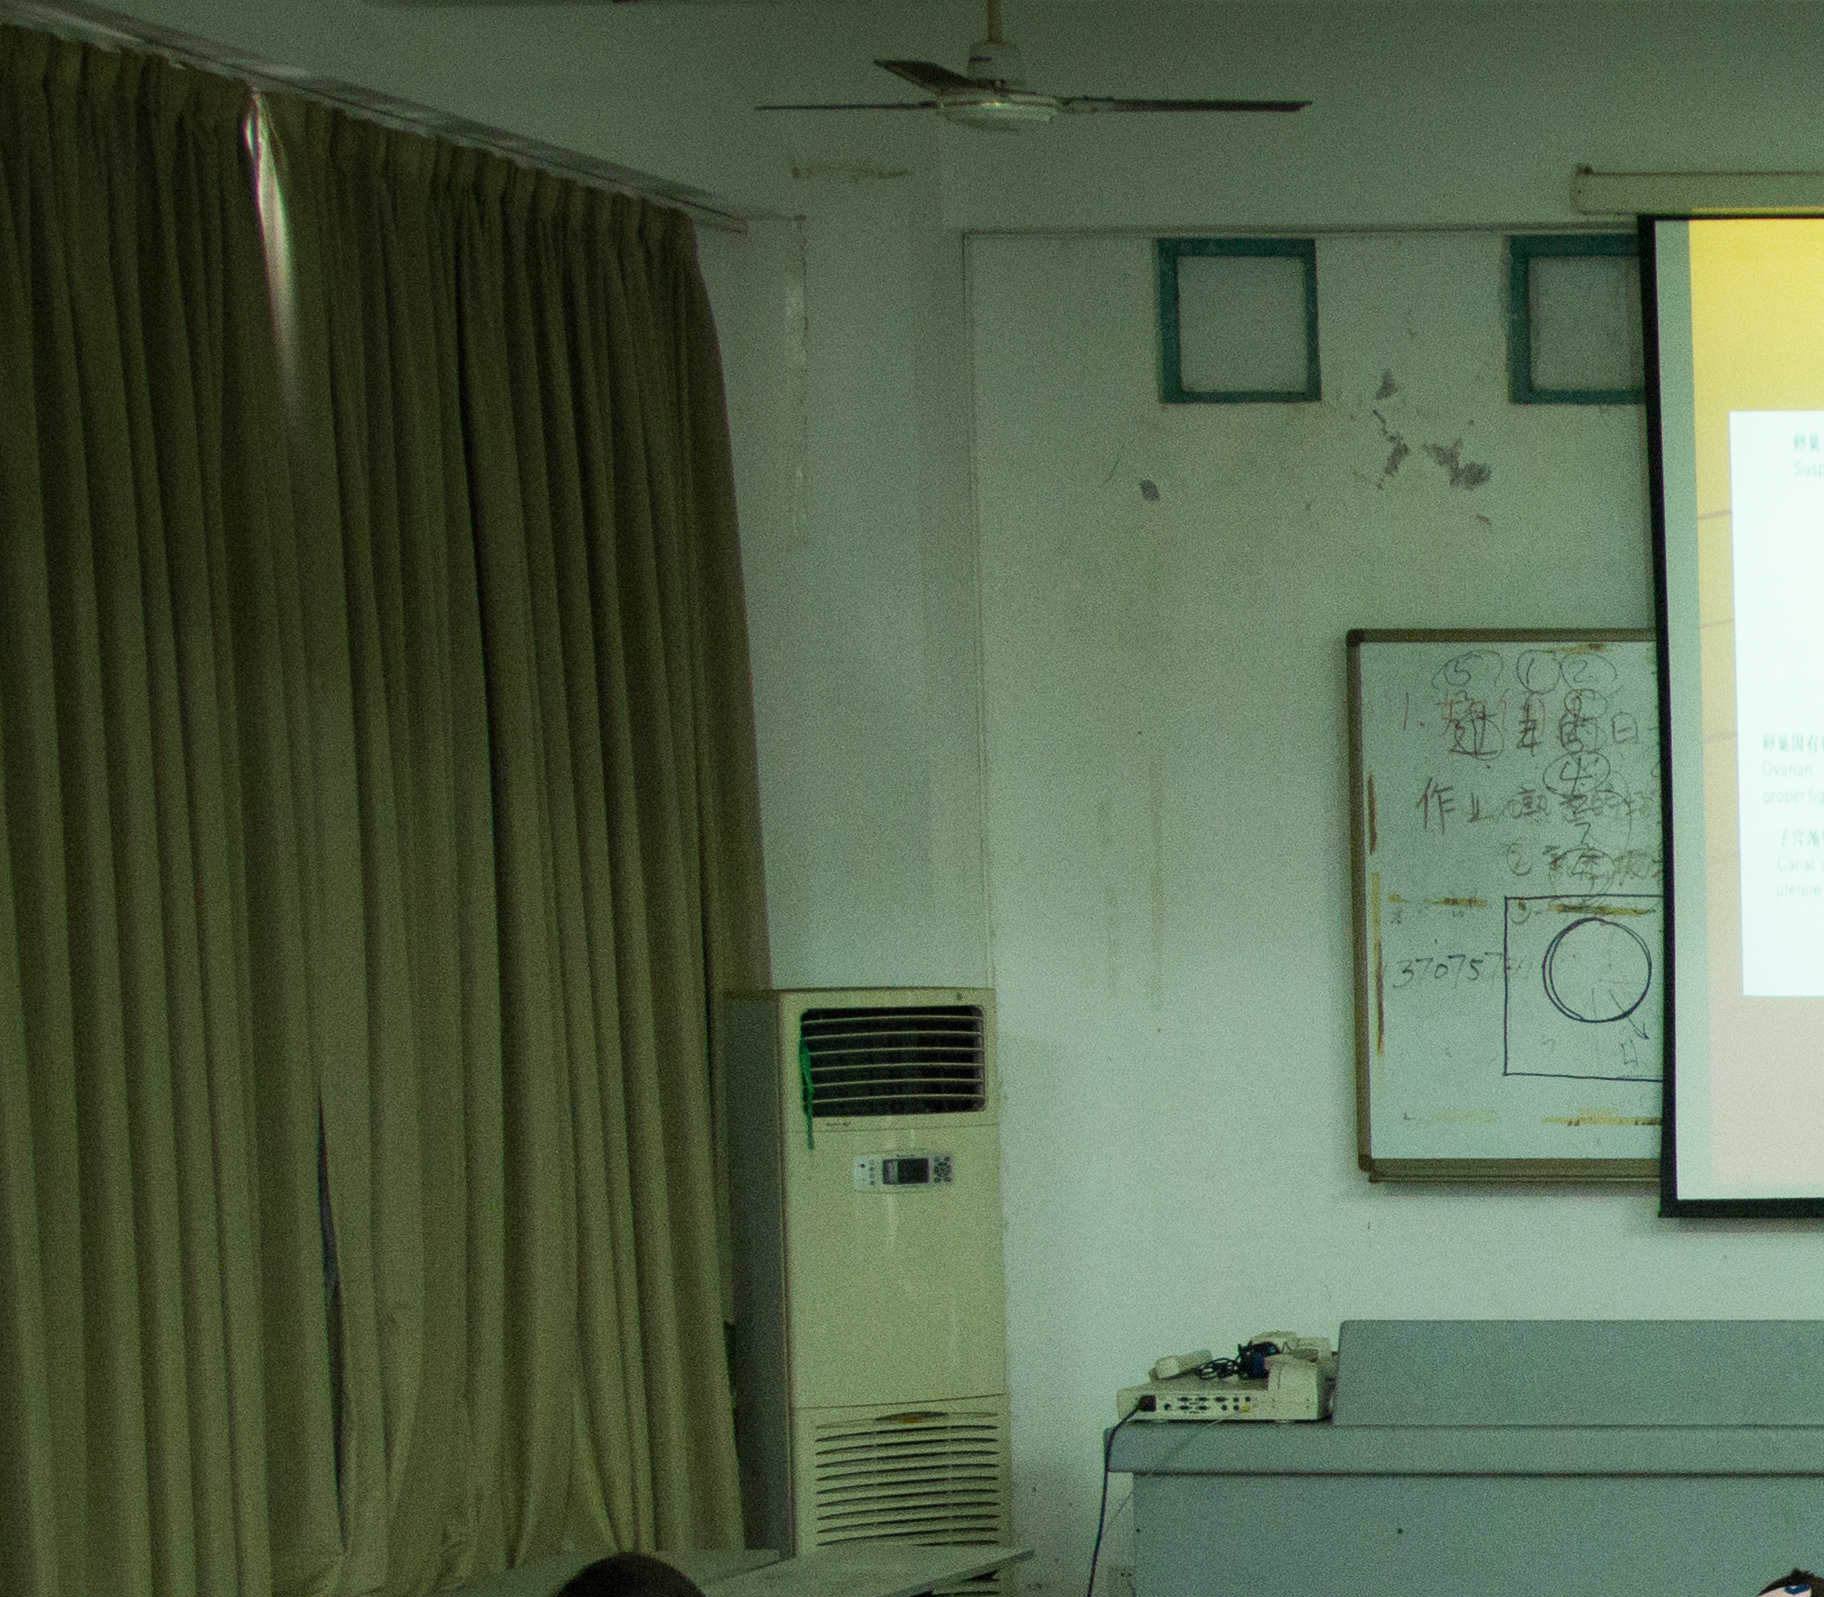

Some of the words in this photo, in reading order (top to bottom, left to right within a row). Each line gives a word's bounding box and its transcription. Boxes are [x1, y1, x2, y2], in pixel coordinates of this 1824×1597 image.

[1762, 761, 1813, 777] Ovarian
[1763, 790, 1805, 806] proper
[1777, 856, 1815, 872] Canal
